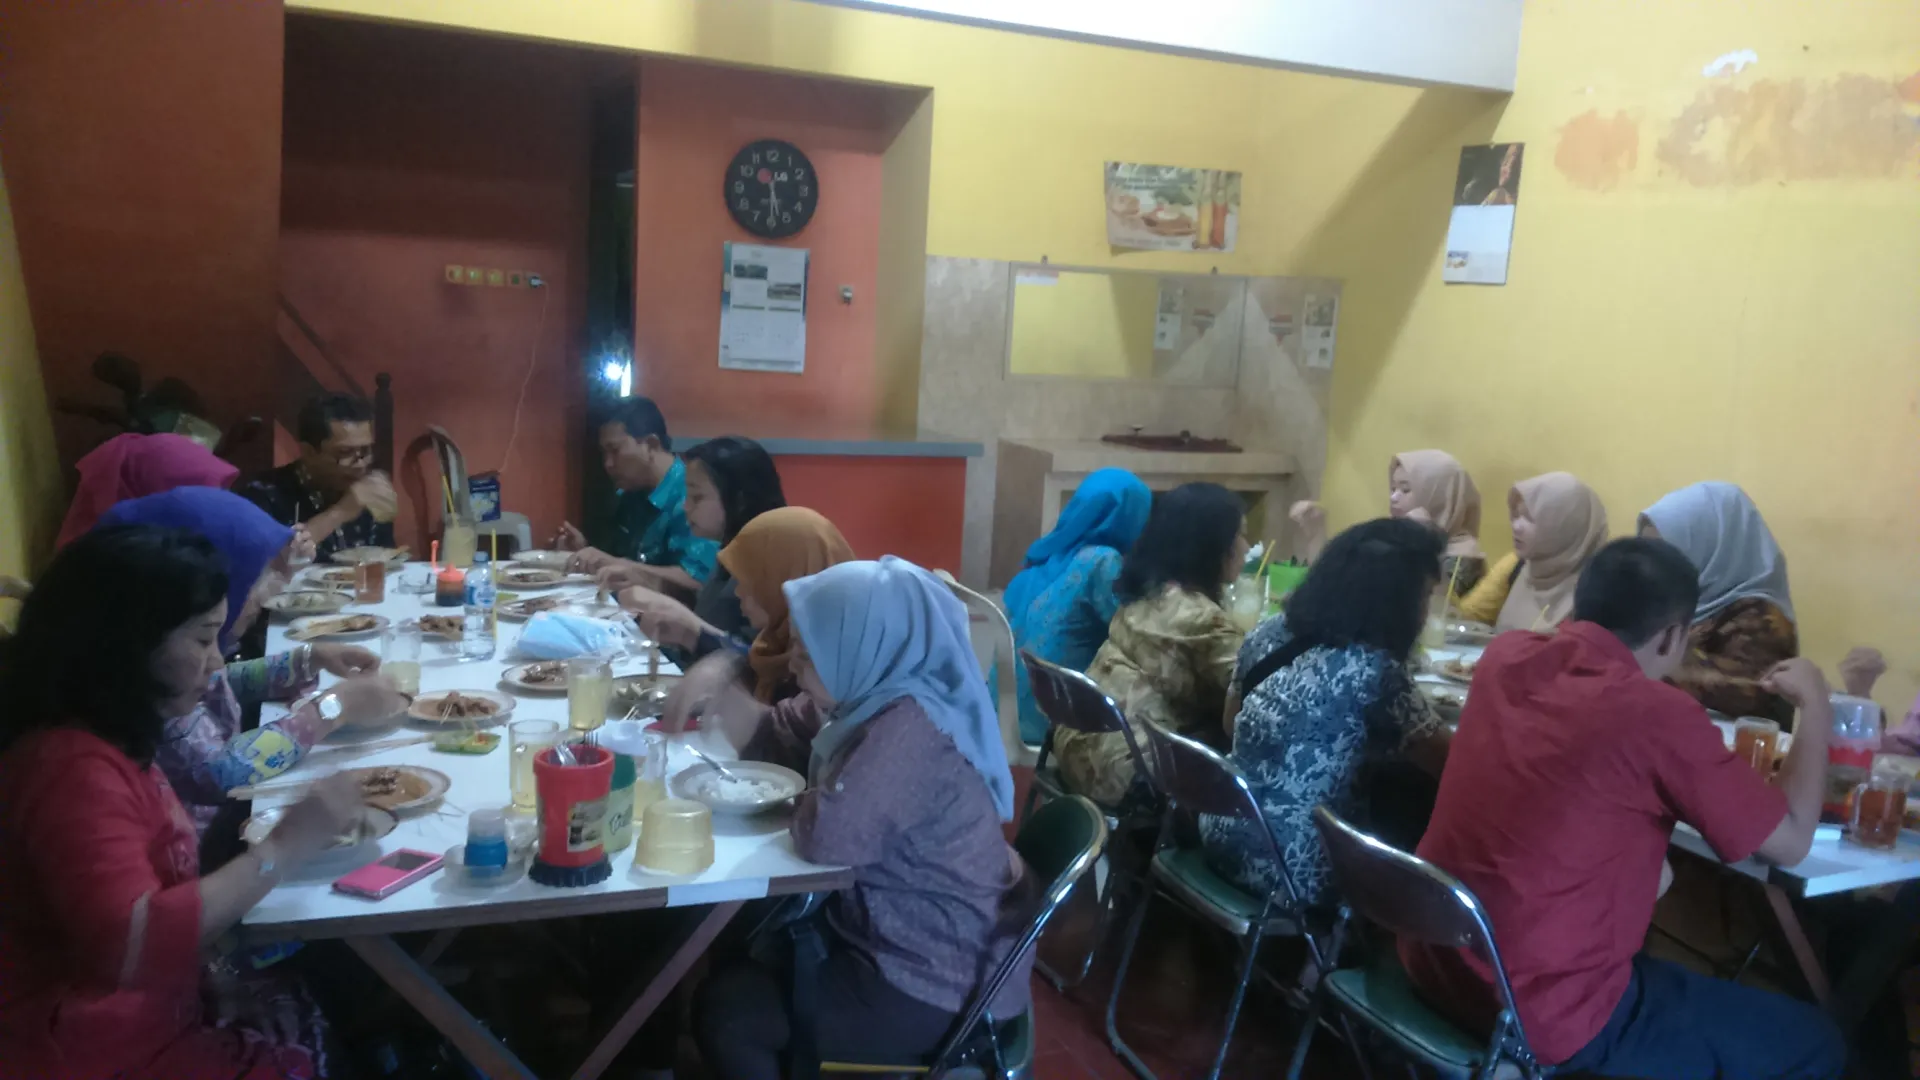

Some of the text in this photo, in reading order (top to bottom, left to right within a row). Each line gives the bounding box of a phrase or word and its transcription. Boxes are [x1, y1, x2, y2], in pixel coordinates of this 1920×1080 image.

[752, 152, 760, 165] 11
[766, 150, 780, 163] 12
[787, 155, 793, 168] 1
[741, 165, 754, 178] 10
[795, 168, 804, 181] 2
[735, 181, 744, 194] 9
[800, 185, 809, 197] 3
[794, 201, 803, 213] 4
[753, 210, 761, 223] 7
